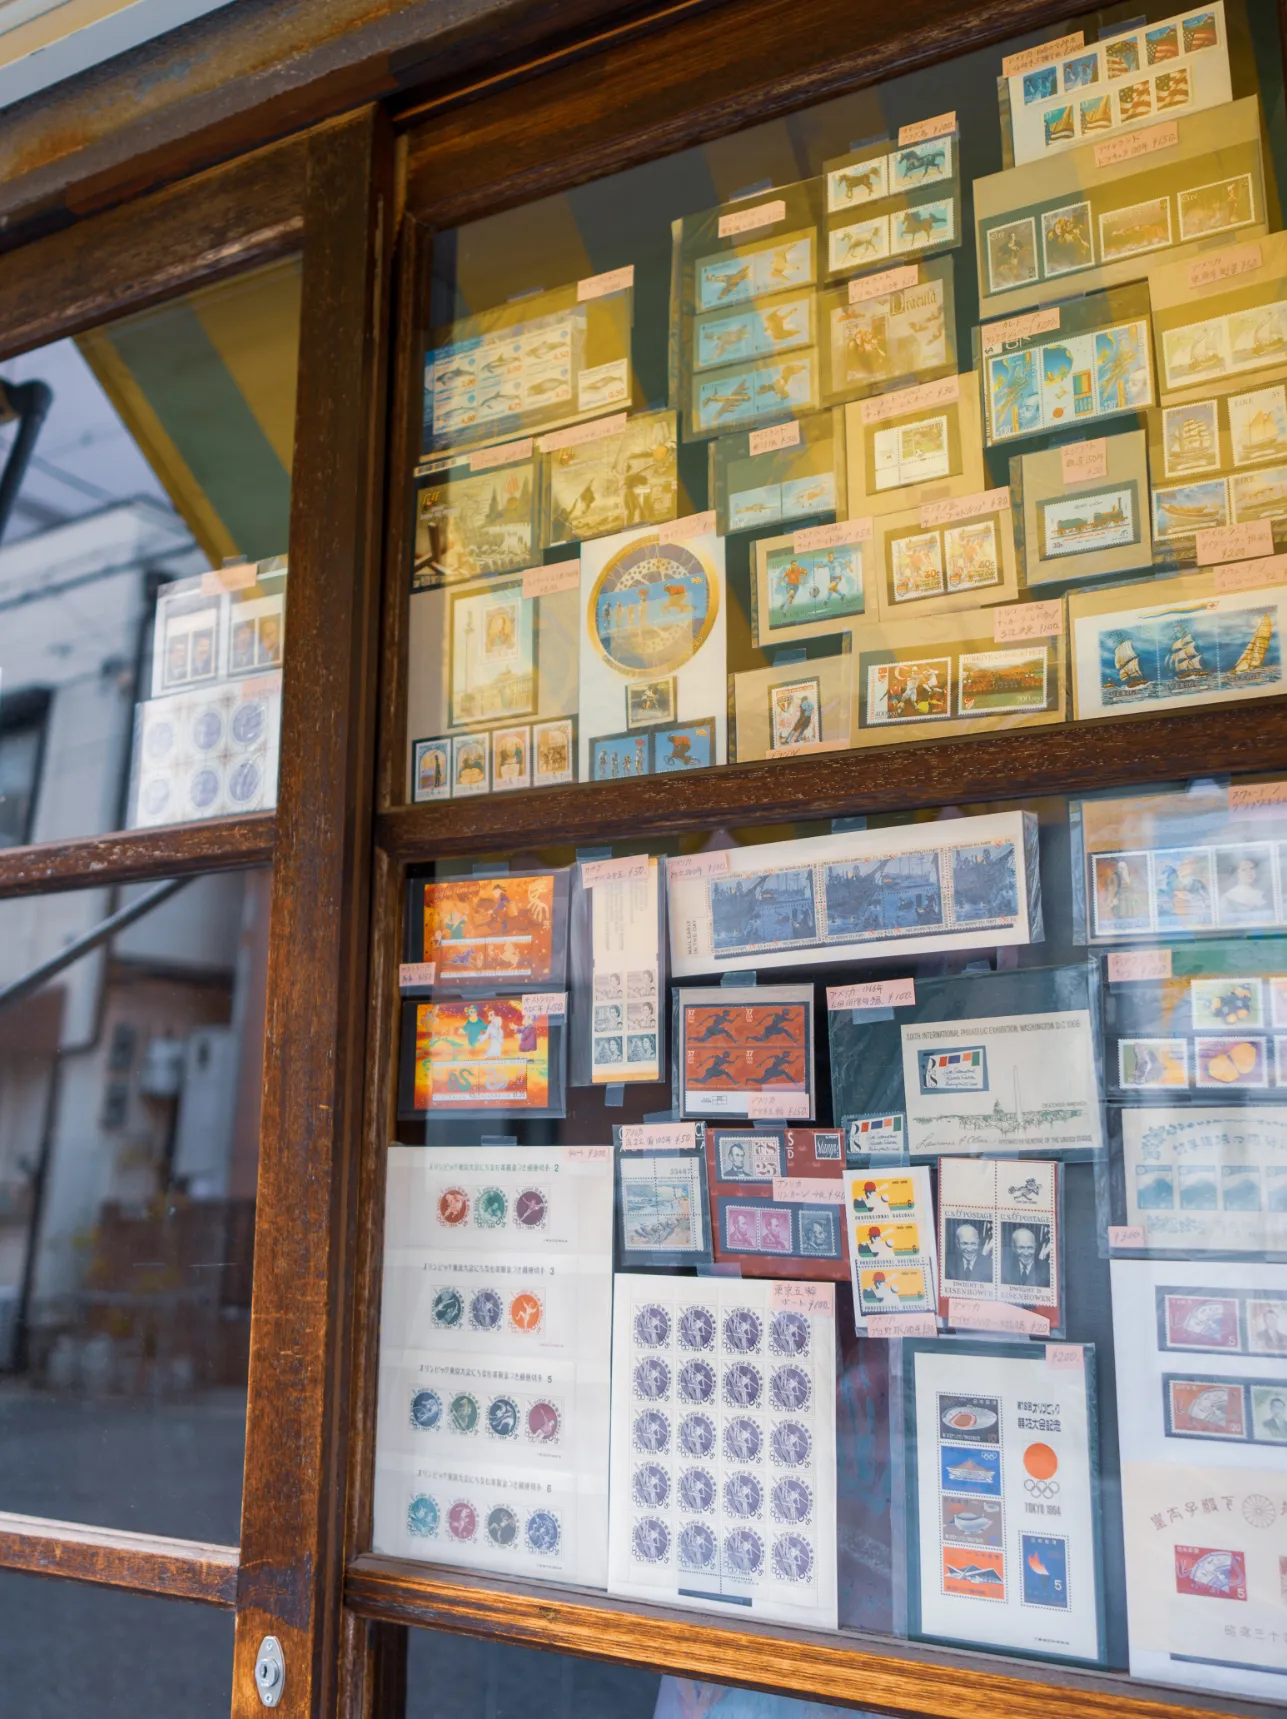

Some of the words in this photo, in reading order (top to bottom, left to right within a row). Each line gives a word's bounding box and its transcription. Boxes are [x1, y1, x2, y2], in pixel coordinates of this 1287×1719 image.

[921, 1029, 960, 1040] INTERNATIONAL
[554, 1163, 560, 1173] 2
[549, 1266, 555, 1276] 3
[547, 1375, 553, 1384] 5
[546, 1484, 552, 1494] 6
[1054, 1579, 1063, 1591] 5
